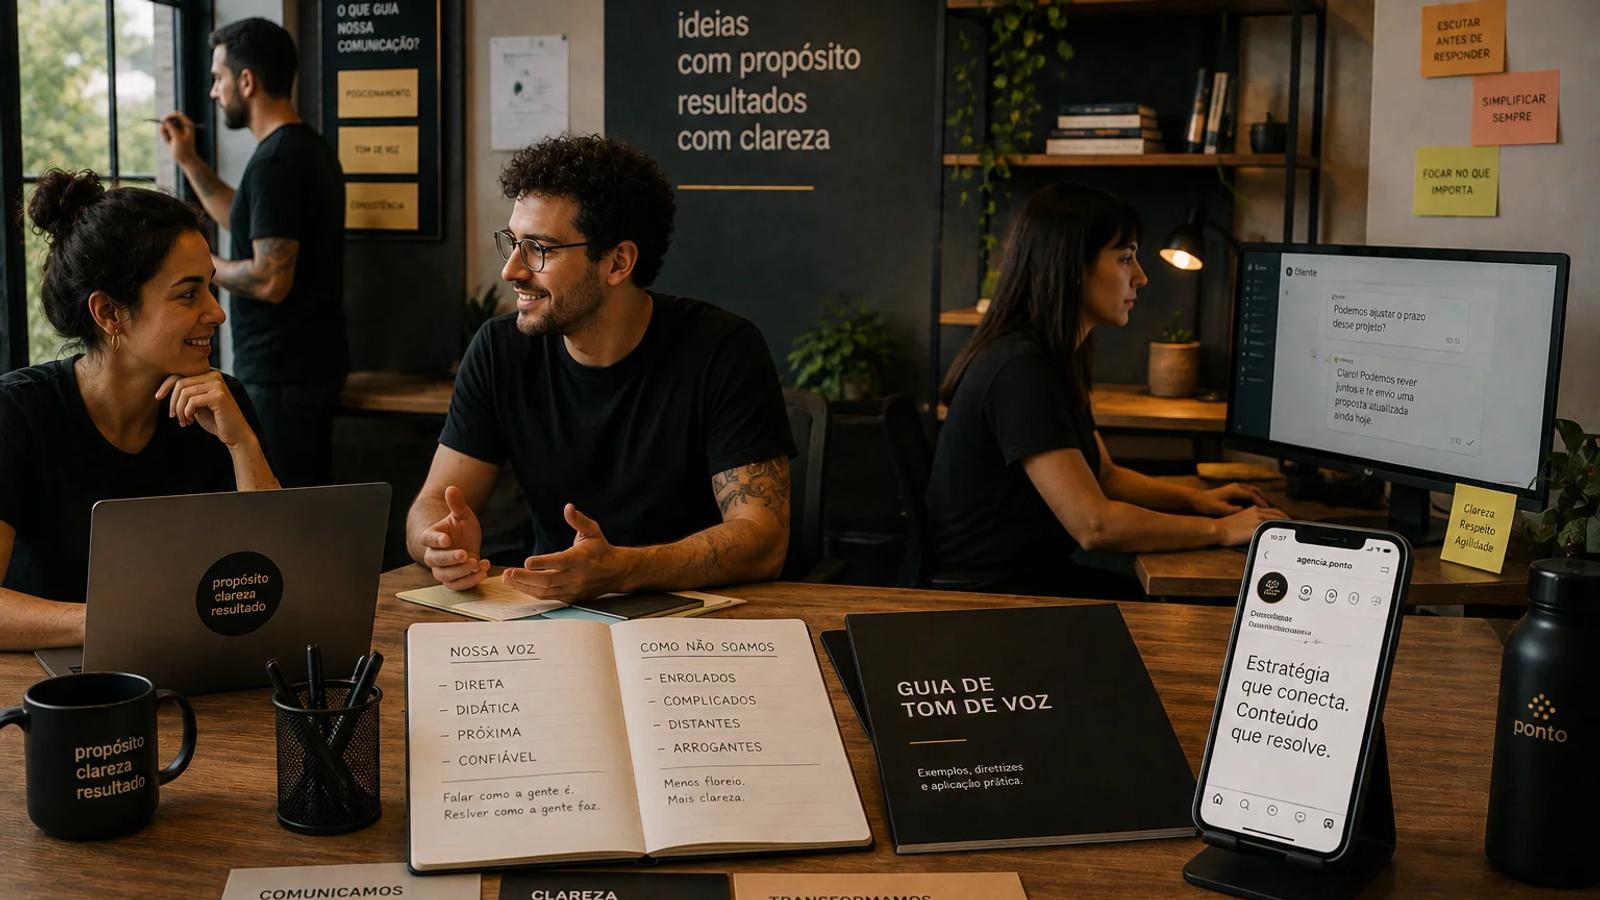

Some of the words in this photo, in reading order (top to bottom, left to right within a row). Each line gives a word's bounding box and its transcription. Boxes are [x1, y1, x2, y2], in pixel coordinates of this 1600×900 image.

[337, 4, 346, 17] O
[348, 3, 370, 17] QUE
[373, 2, 399, 15] GUIA
[337, 21, 374, 34] NOSSA
[677, 9, 749, 38] ideias
[1437, 18, 1480, 31] ESCUTAR
[337, 35, 420, 54] COMUNICAÇÃO?
[1436, 34, 1467, 46] ANTES
[1470, 33, 1483, 43] DE
[677, 52, 731, 75] com
[739, 42, 861, 79] propósito
[1433, 48, 1490, 62] RESPONDER
[346, 88, 411, 98] POSICIONAMENTO
[677, 86, 807, 115] resultados
[1482, 93, 1546, 107] SIMPLIFICAR
[1492, 111, 1532, 123] SEMPRE
[677, 129, 731, 151] com
[739, 123, 830, 150] clareza
[355, 144, 371, 154] TOM
[1423, 169, 1452, 179] FOCAR
[1455, 169, 1468, 179] NO
[1472, 168, 1490, 179] QUE
[1431, 185, 1473, 195] IMPORTA
[1334, 304, 1368, 317] Podemos
[1369, 309, 1395, 319] ajustar
[1396, 311, 1402, 319] o
[1403, 313, 1426, 322] prazo
[1332, 320, 1354, 330] desse
[1355, 323, 1386, 333] projeto?
[1337, 367, 1358, 379] Claro!
[1360, 370, 1395, 384] Podemos
[1397, 377, 1418, 387] rever
[1335, 382, 1358, 393] juntos
[1366, 386, 1374, 396] te
[1375, 388, 1395, 399] envio
[1397, 393, 1414, 402] uma
[1335, 397, 1367, 410] proposta
[1368, 402, 1408, 415] atualizada
[1333, 411, 1354, 422] ainda
[1355, 415, 1374, 426] hoje.
[1463, 503, 1495, 518] Clareza
[1459, 519, 1496, 536] Respeito
[1455, 536, 1494, 553] Agilidade
[1296, 556, 1352, 569] agencia.ponto
[212, 573, 269, 591] propósito
[214, 590, 256, 602] clareza
[211, 601, 266, 616] resultado
[450, 645, 499, 657] NOSSA
[506, 644, 536, 655] VOZ
[640, 642, 680, 652] COMO
[686, 639, 714, 652] NÃO
[721, 642, 775, 652] SOAMOS
[1246, 655, 1330, 684] Estratégia
[455, 679, 504, 691] DIRETA
[659, 673, 736, 683] ENROLADOS
[897, 679, 956, 696] GUIA
[962, 676, 994, 693] DE
[663, 695, 757, 707] COMPLICADOS
[1241, 680, 1272, 697] que
[1277, 686, 1349, 712] conecta.
[456, 701, 520, 715] DIDÁTICA
[901, 699, 957, 718] TOM
[964, 698, 997, 714] DE
[1001, 694, 1053, 712] VOZ
[668, 718, 741, 730] DISTANTES
[1236, 702, 1319, 731] Conteúdo
[1513, 720, 1567, 743] ponto
[75, 736, 144, 763] propósito
[673, 741, 763, 754] ARROGANTES
[1231, 727, 1262, 744] que
[1266, 733, 1331, 758] resolve.
[459, 750, 537, 766] CONFIÁVEL
[76, 760, 132, 780] clareza
[77, 774, 145, 800] resultado
[664, 778, 699, 788] Menos
[704, 775, 745, 786] floreio.
[921, 783, 928, 791] e
[443, 792, 473, 803] Falar
[479, 792, 510, 801] como
[527, 787, 559, 801] gente
[668, 794, 694, 805] Mais
[700, 792, 745, 803] clareza.
[494, 807, 524, 817] como
[529, 806, 537, 814] a
[541, 803, 573, 817] gente
[578, 799, 601, 812] faz.
[259, 886, 403, 900] COMUNICAMOS
[531, 890, 618, 900] CLAREZA
